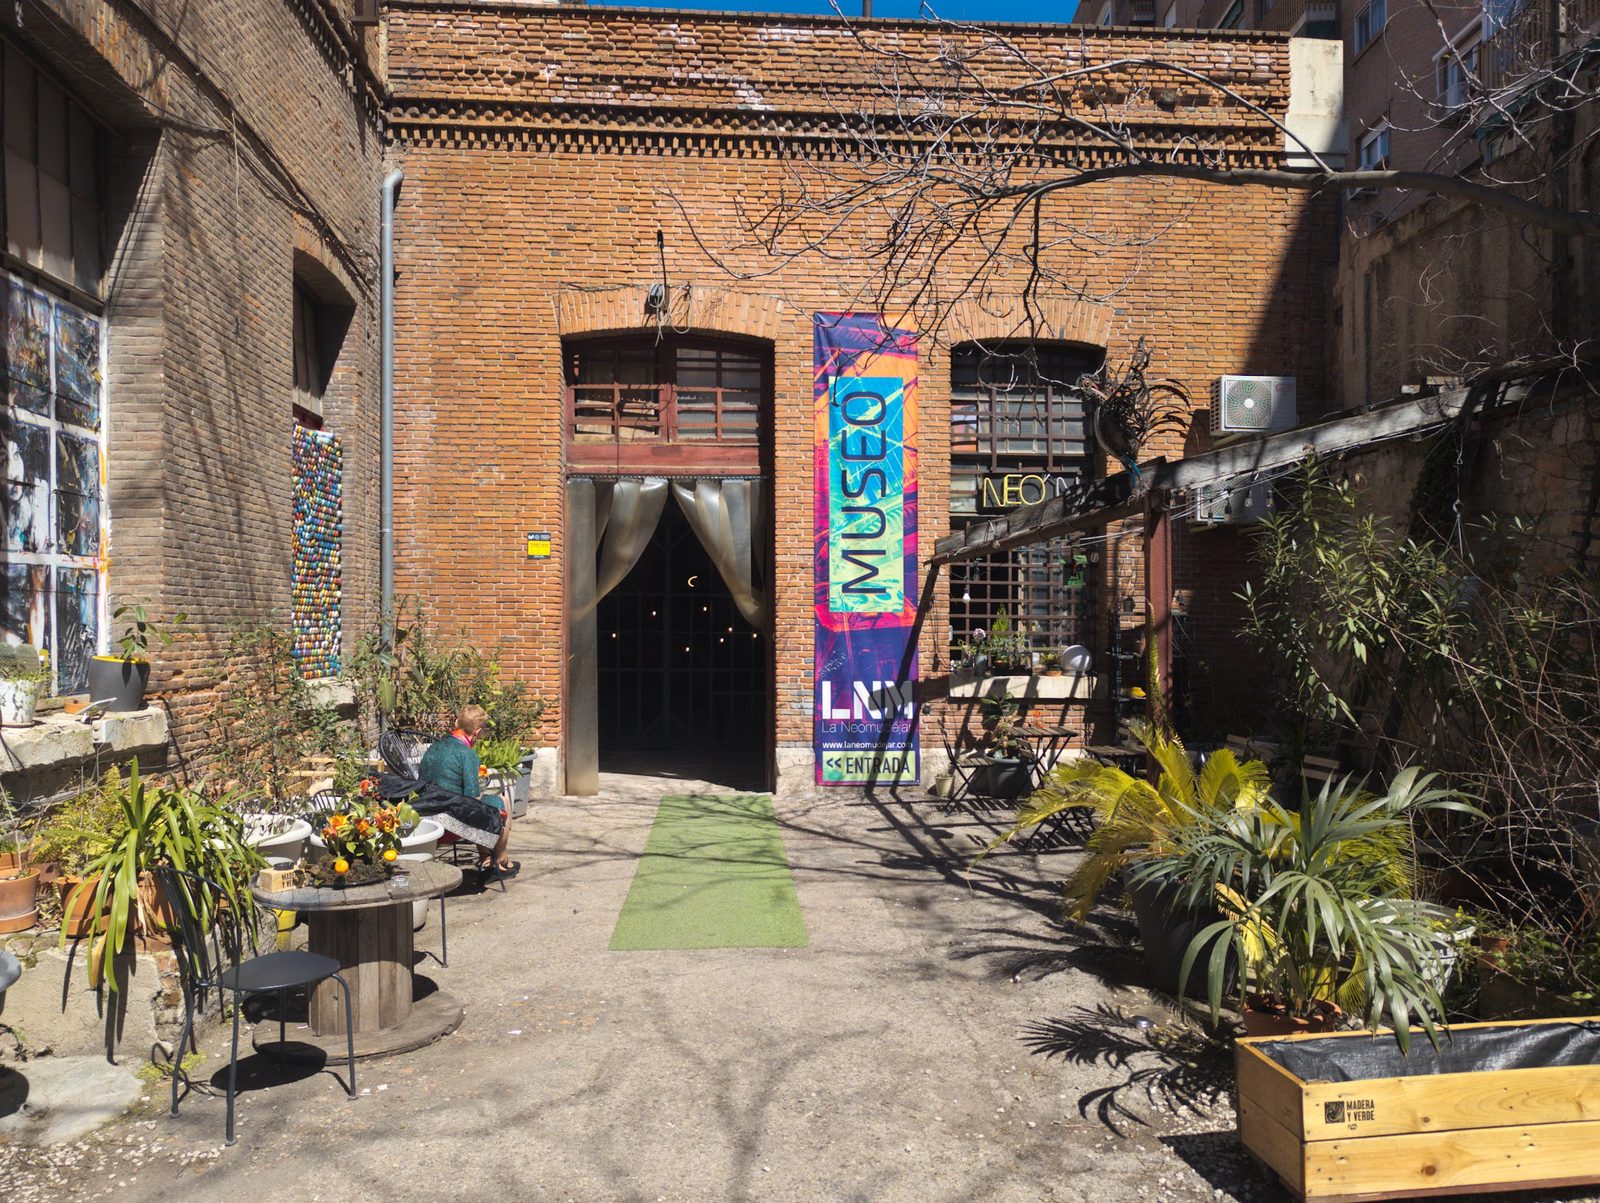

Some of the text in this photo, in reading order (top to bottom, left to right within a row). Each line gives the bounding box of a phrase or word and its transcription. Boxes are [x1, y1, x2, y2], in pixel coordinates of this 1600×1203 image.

[841, 391, 887, 595] MUSEO
[822, 681, 914, 719] LNM
[822, 721, 837, 733] La
[846, 757, 910, 774] ENTRADA
[1346, 1099, 1375, 1110] MADERA
[1347, 1110, 1375, 1121] Y VERDE
